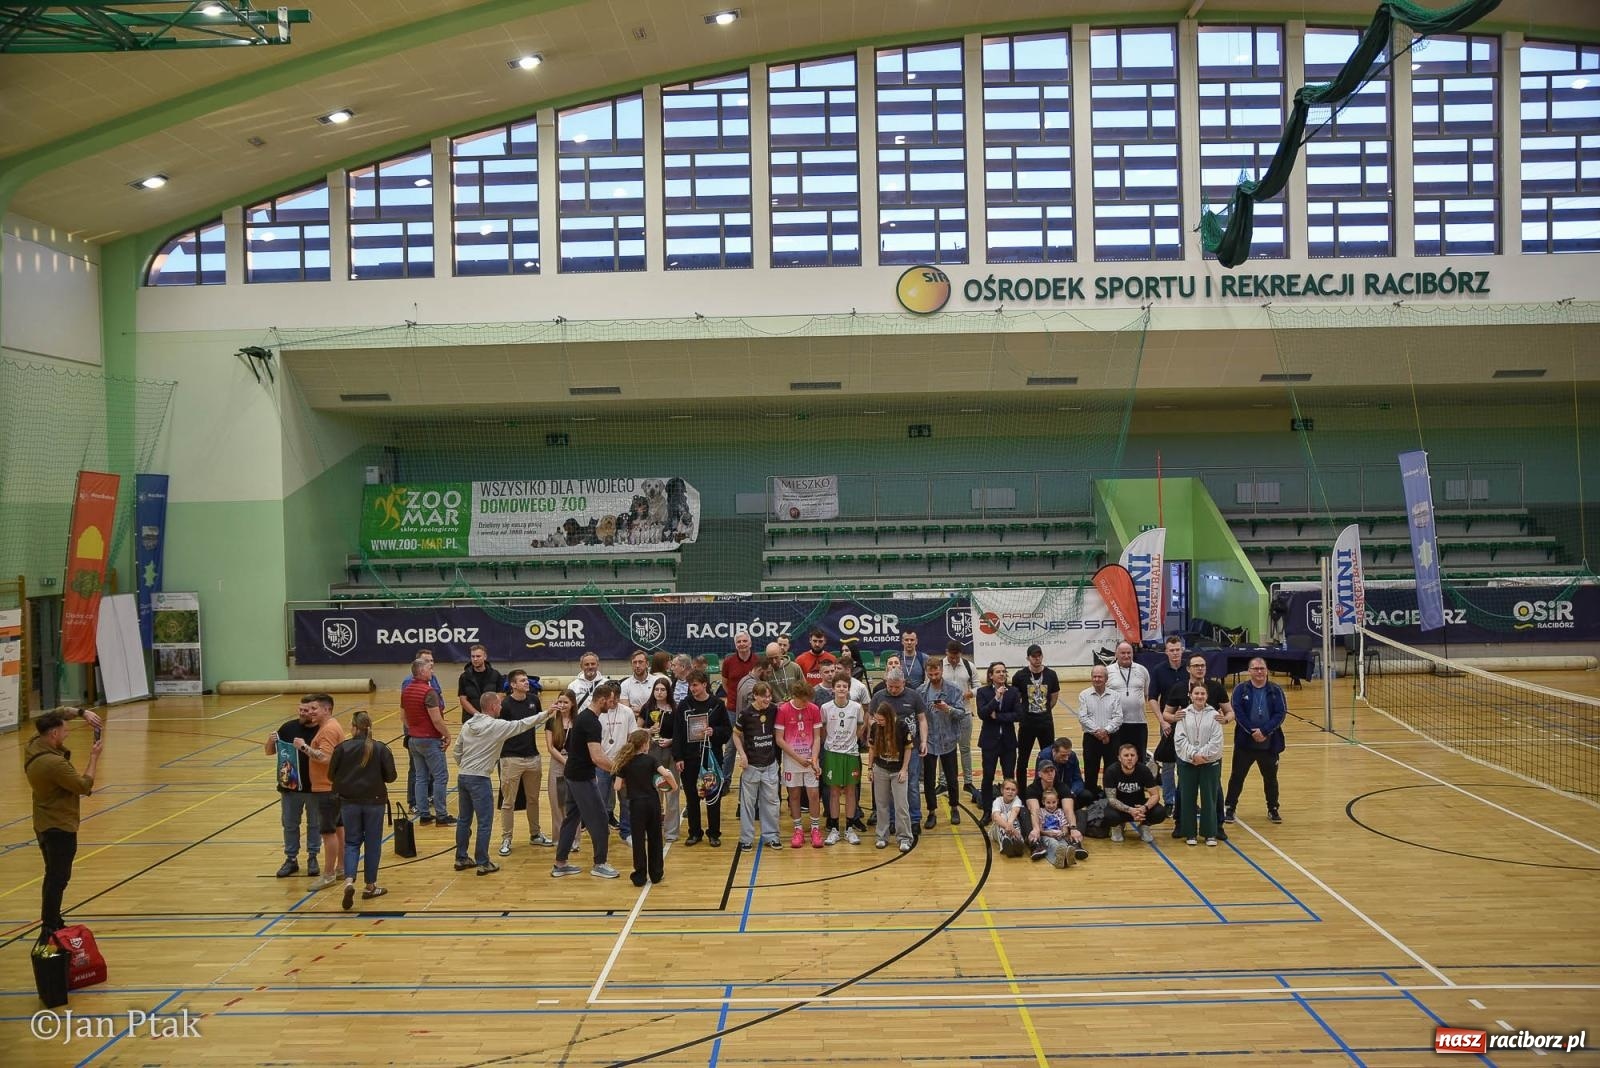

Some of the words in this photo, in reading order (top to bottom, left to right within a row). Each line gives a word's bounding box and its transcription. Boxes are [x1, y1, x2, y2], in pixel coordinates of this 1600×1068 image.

[963, 273, 1085, 301] OŚRODEK
[1095, 275, 1195, 299] SPORTU
[1205, 275, 1211, 297] I
[1221, 273, 1354, 297] REKREACJI
[1364, 267, 1490, 295] RACIBÓRZ
[480, 480, 546, 497] WSZYSTKO
[551, 480, 574, 495] DLA
[578, 477, 635, 495] TWOJEGO
[781, 478, 830, 490] MIESZKO
[406, 490, 462, 509] ZOO
[480, 498, 556, 514] DOMOWEGO
[561, 496, 587, 512] ZOO
[401, 509, 460, 527] MAR
[370, 537, 458, 551] WWW.ZOO-MAR.PL
[1149, 553, 1161, 631] BASKETBALL
[1337, 549, 1357, 625] MINI
[1002, 619, 1118, 632] VANESSA
[1363, 608, 1468, 626] RACIBRZ
[1537, 621, 1575, 629] RACIBÓRZ
[376, 623, 480, 644] RACIBÓRZ
[686, 617, 792, 639] RACIBÓRZ
[549, 640, 585, 648] RACIBÓRZ
[863, 635, 900, 643] RACIBÓRZ
[839, 719, 845, 728] 4
[784, 771, 792, 782] 10
[827, 770, 833, 780] 4
